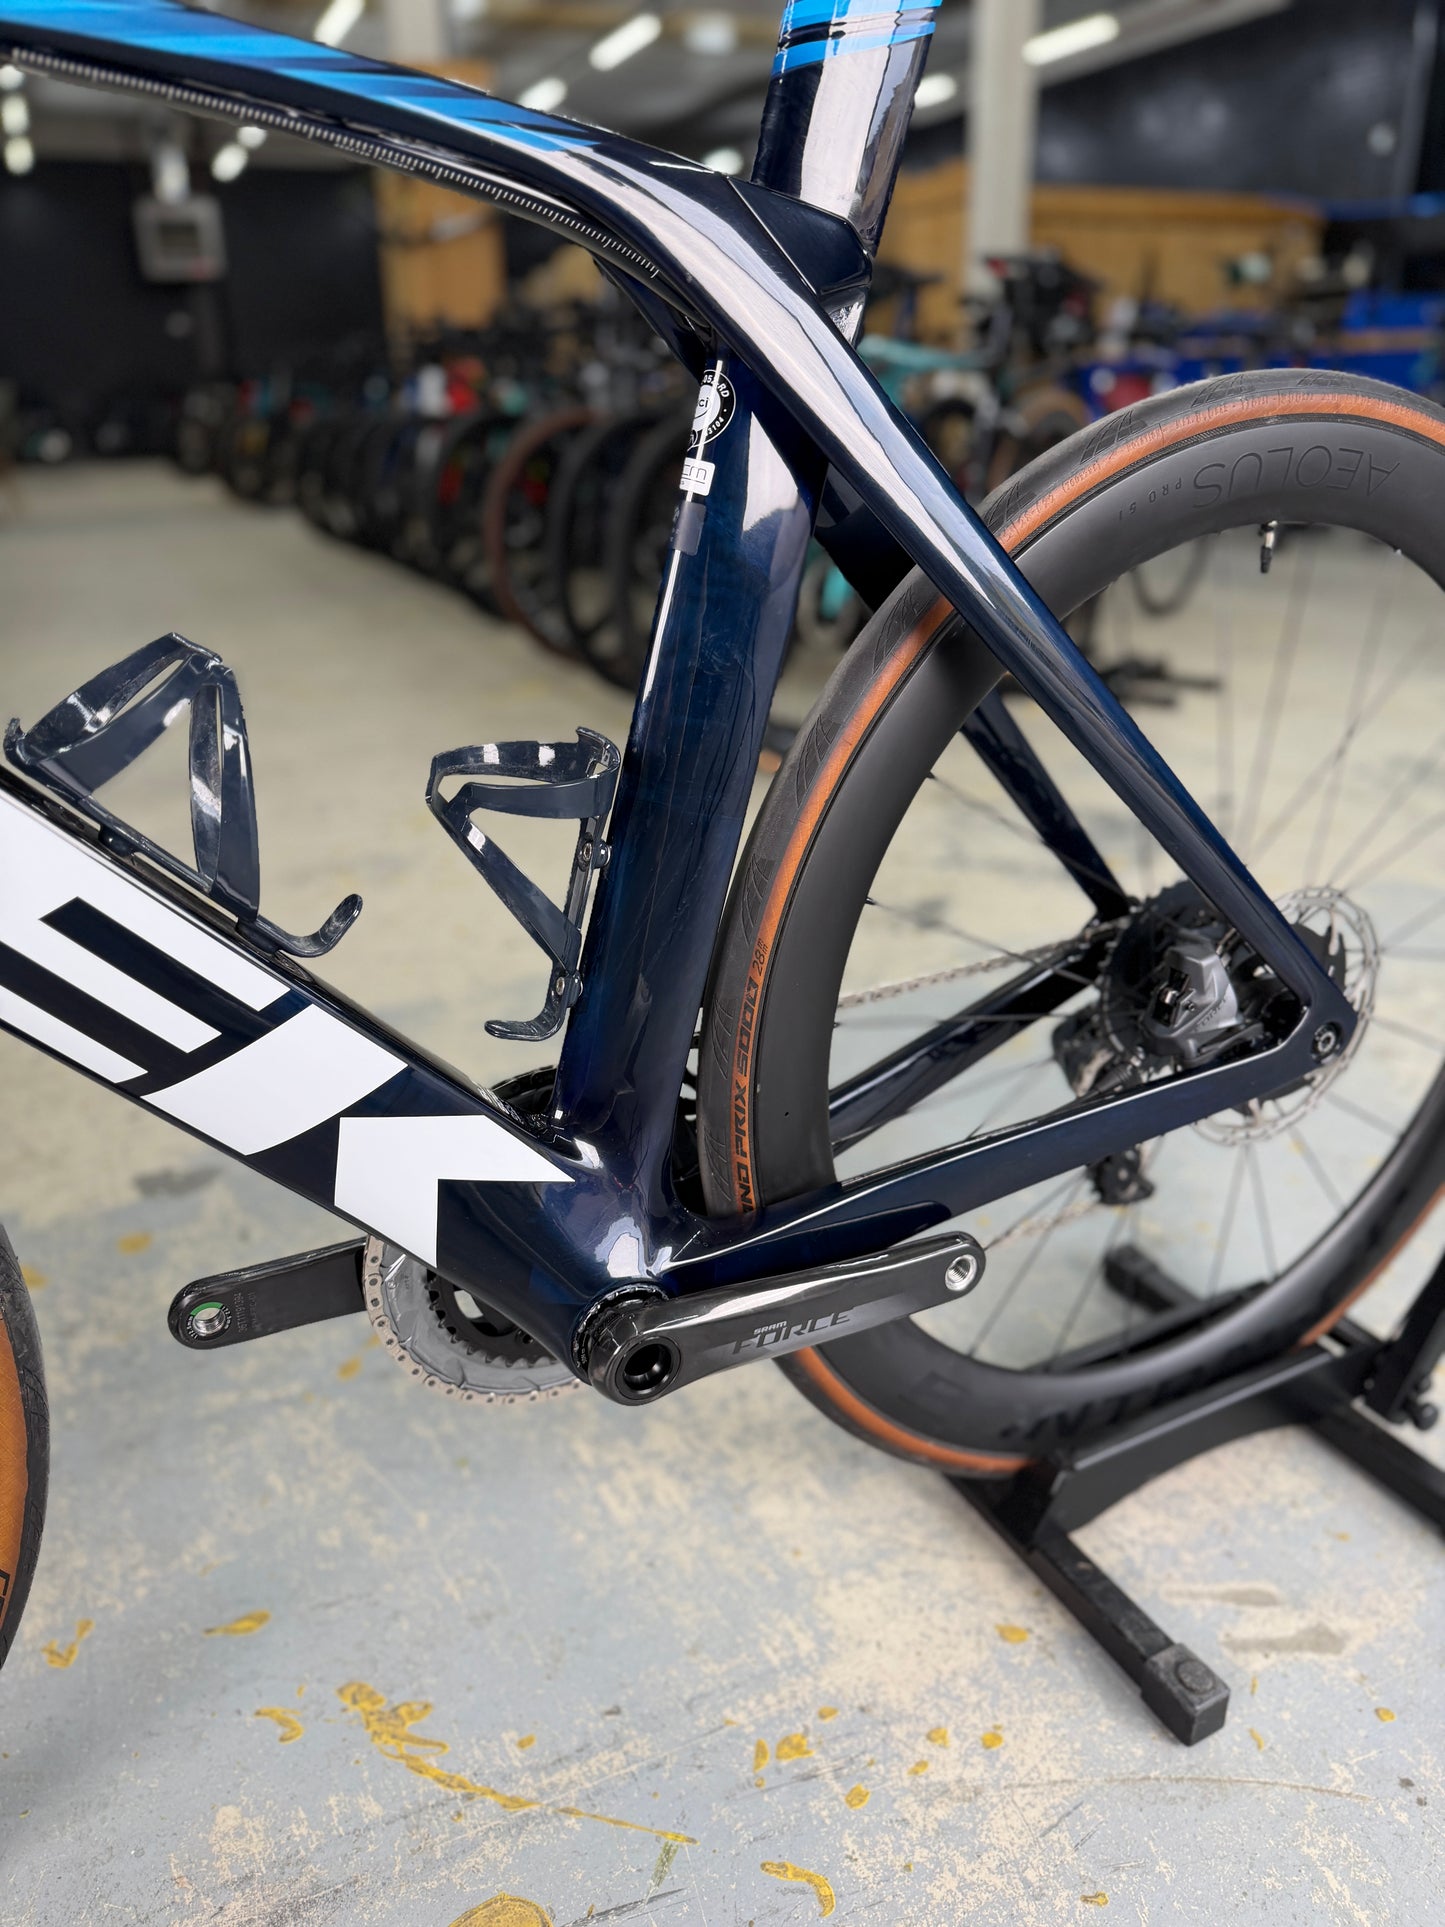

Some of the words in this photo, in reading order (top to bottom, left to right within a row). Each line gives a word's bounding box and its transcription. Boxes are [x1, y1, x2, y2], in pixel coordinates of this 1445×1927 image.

[1147, 477, 1183, 504] PRO
[1193, 444, 1401, 509] AEOLUS
[736, 978, 759, 1077] 5000
[734, 1080, 750, 1157] PRIX
[732, 1310, 852, 1355] FORCE
[753, 1320, 788, 1335] SRAM
